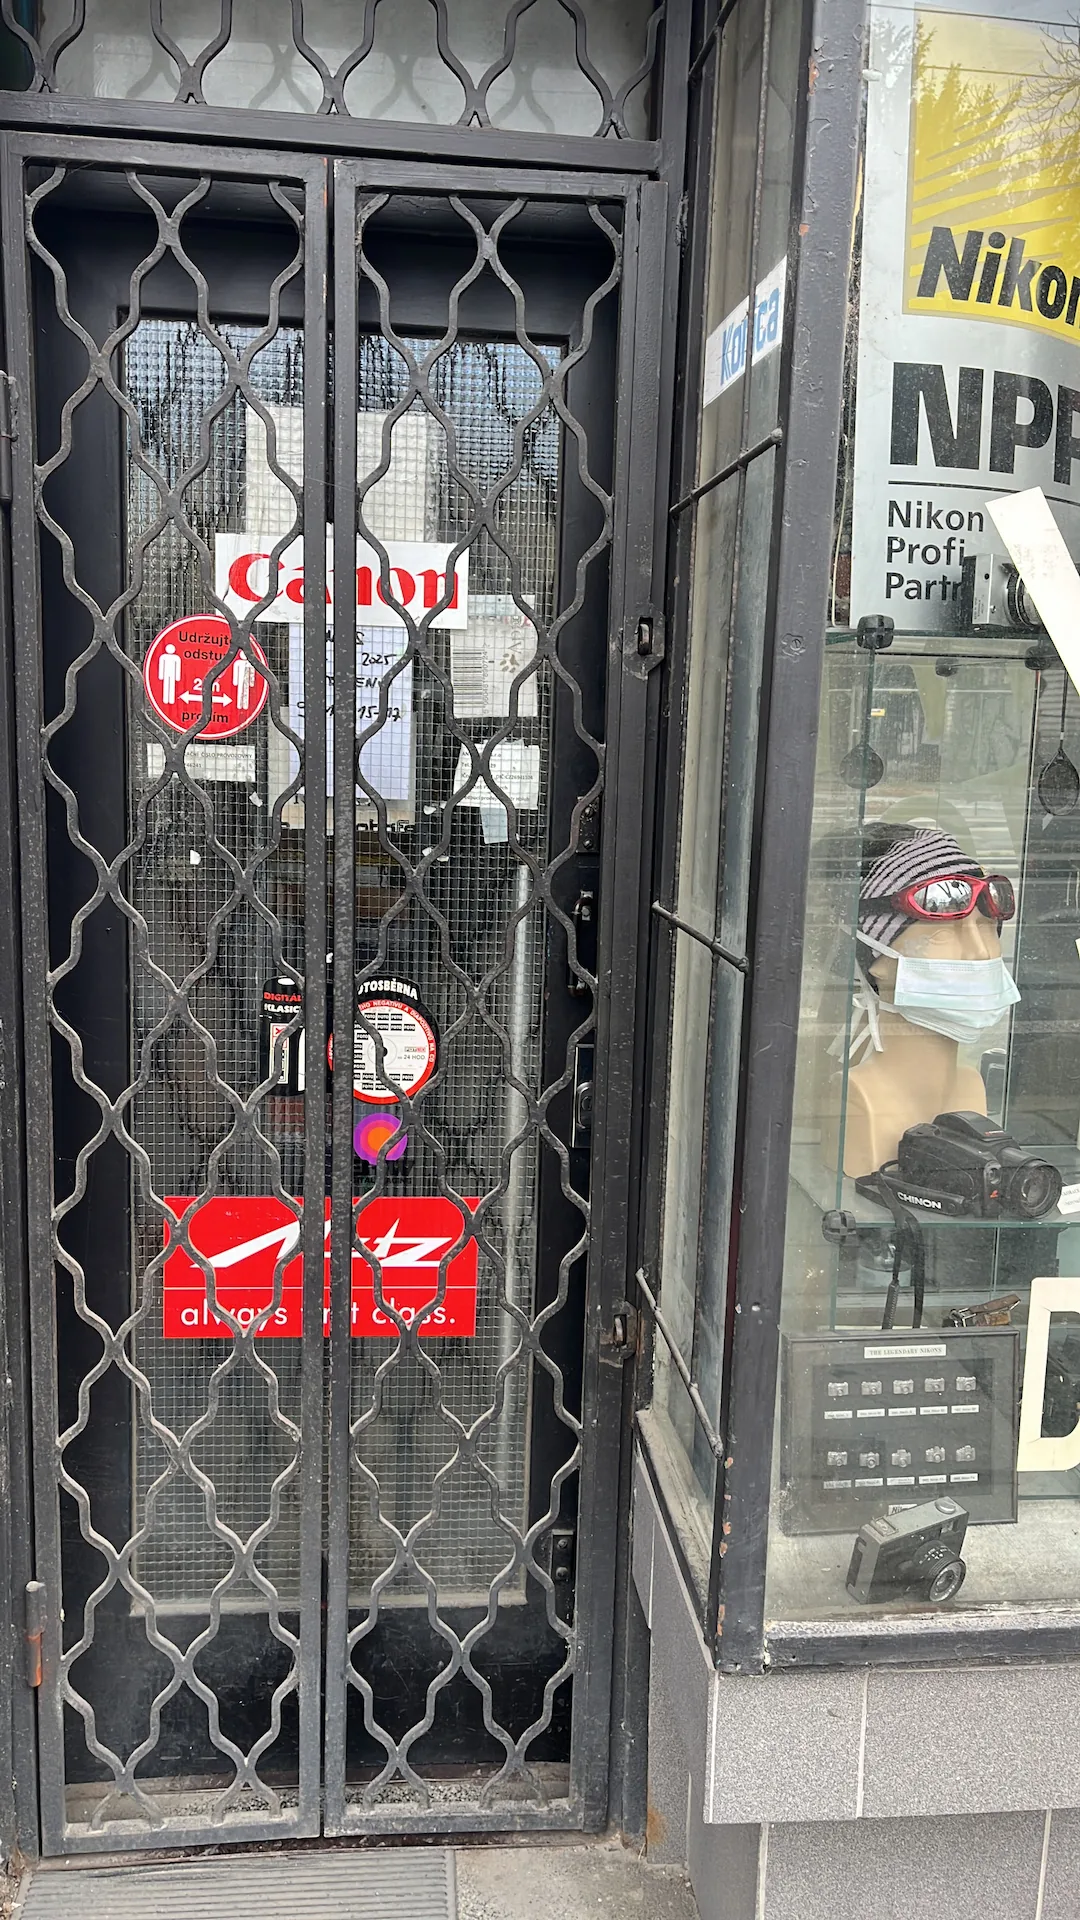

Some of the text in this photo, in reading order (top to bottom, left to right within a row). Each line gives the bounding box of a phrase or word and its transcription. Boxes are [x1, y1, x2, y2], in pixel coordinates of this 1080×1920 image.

[887, 500, 984, 532] Nikon
[886, 536, 966, 567] Profi
[179, 630, 232, 648] Udržujt
[183, 650, 227, 660] odstu
[182, 711, 229, 723] prím
[357, 978, 418, 1001] TOSBĚRNA
[264, 1003, 301, 1014] KLASIC
[897, 1191, 942, 1210] CHINON
[884, 1348, 918, 1356] LEGENDARY
